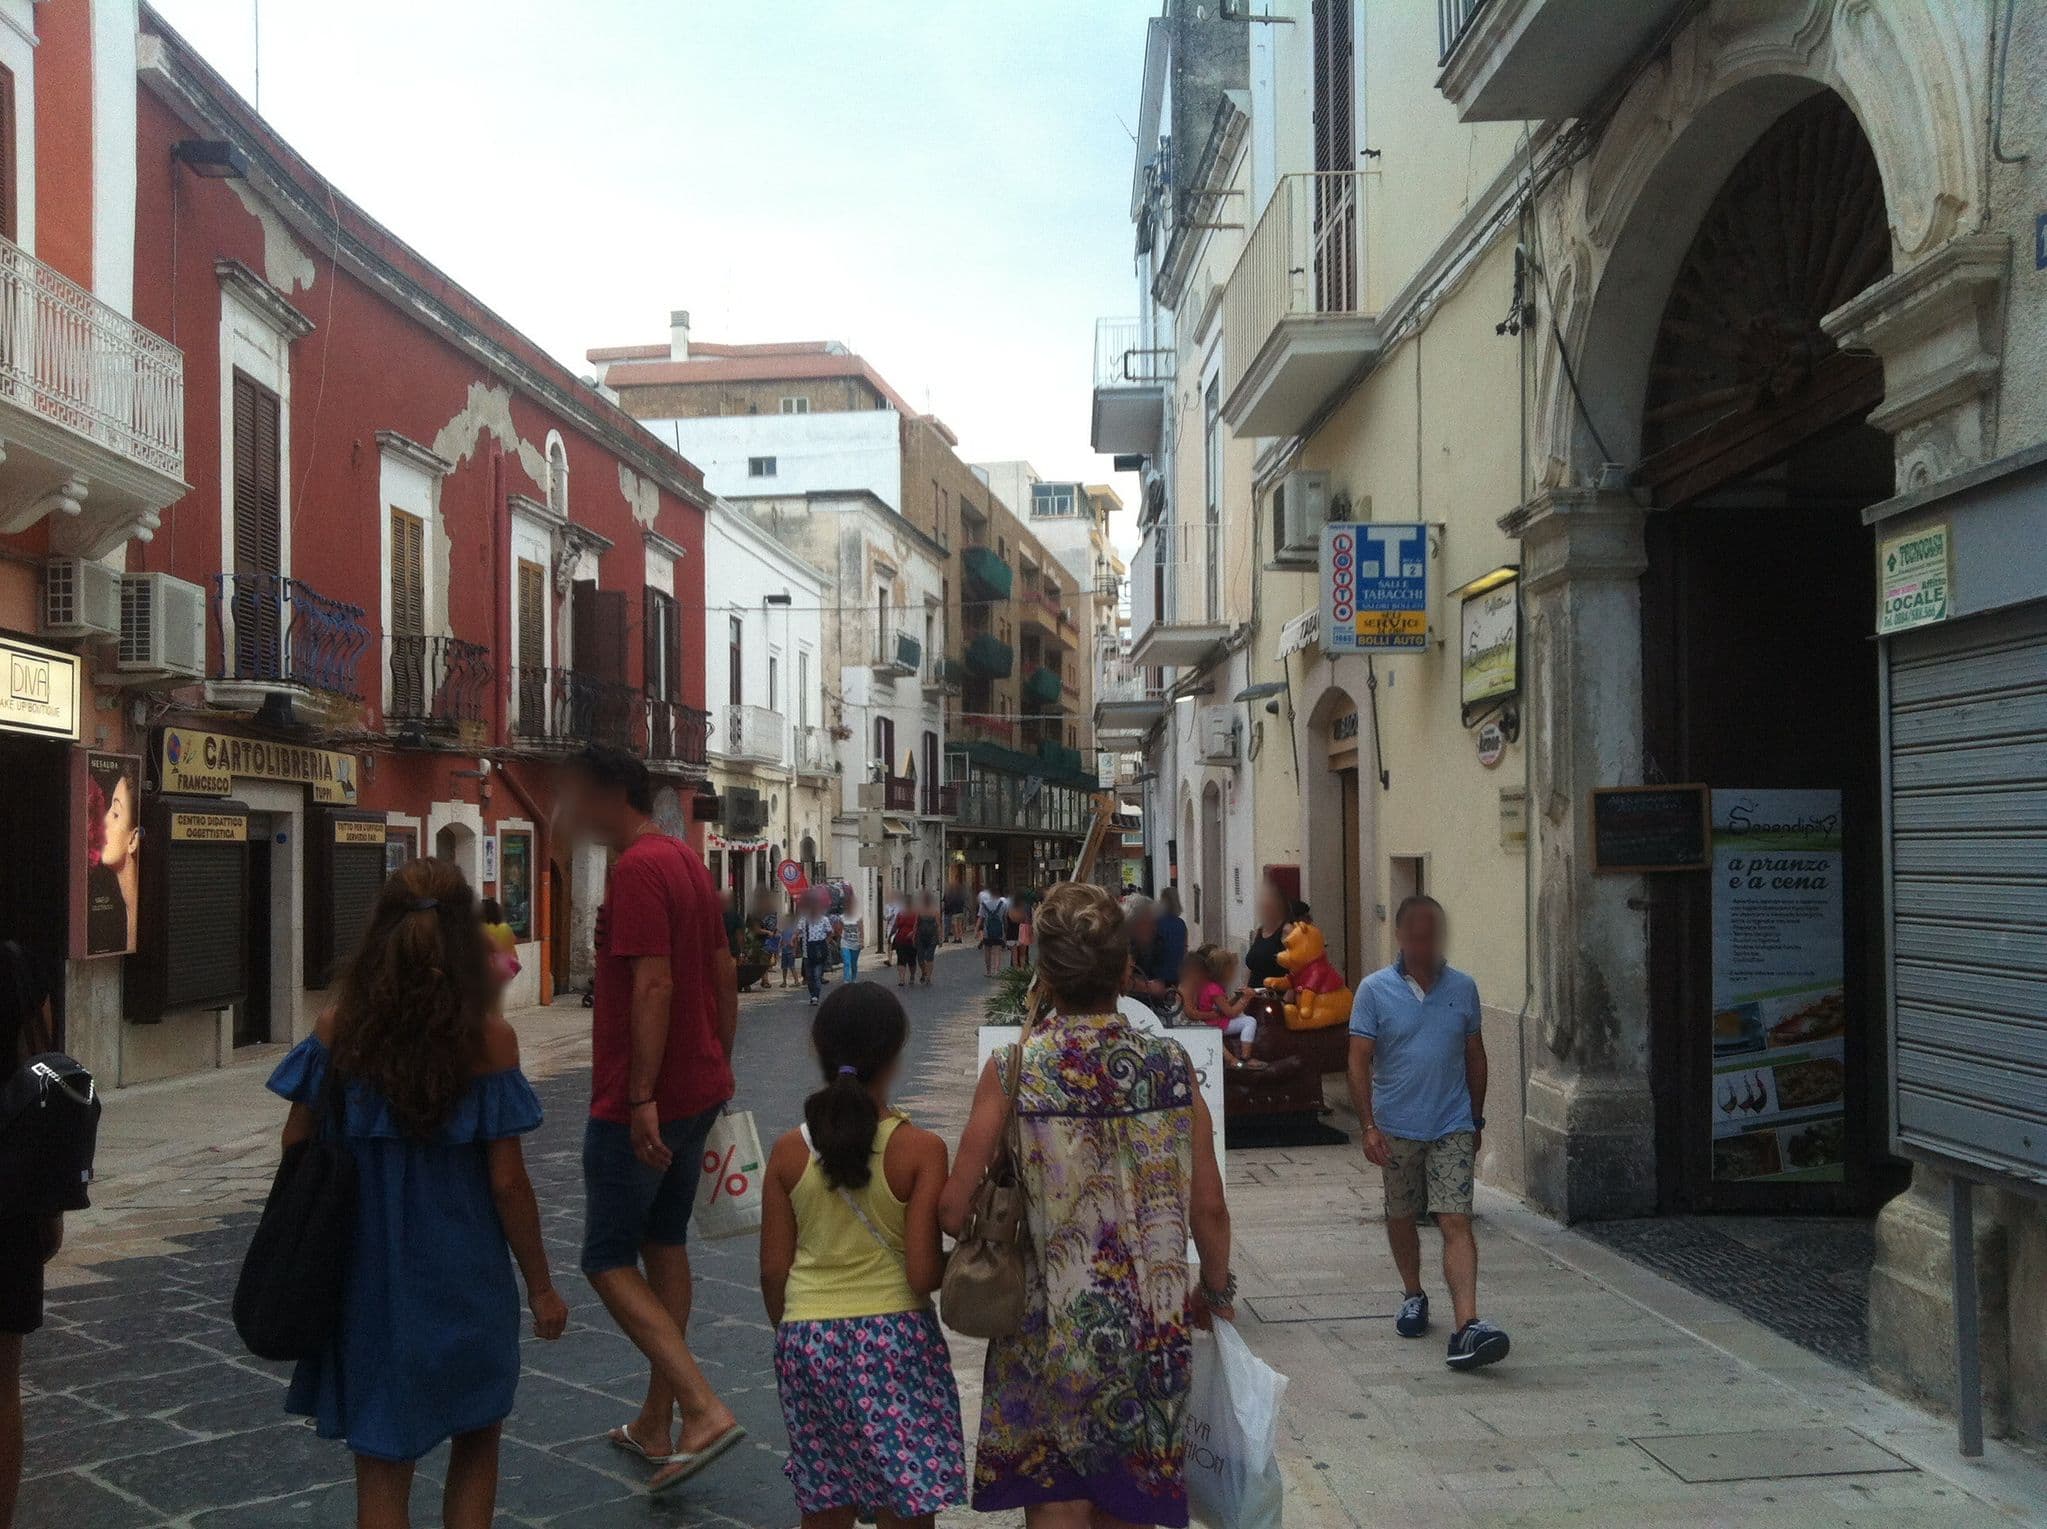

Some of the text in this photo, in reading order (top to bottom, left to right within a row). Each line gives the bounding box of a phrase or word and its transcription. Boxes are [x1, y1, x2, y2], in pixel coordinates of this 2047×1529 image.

[1363, 589, 1423, 600] TABACCHI
[1885, 586, 1944, 614] LOCALE
[1359, 636, 1424, 645] BOLLI AUTO
[14, 662, 46, 697] DIVA
[0, 698, 13, 711] AKE
[203, 736, 333, 780] CARTOLIBRERIA
[178, 774, 229, 792] FRANCESCO
[178, 815, 243, 827] CENTRO DIDATTICO
[186, 828, 235, 839] OGGETTISTICA
[1728, 859, 1831, 876] a pranzo
[1728, 877, 1829, 889] e a cena
[1184, 1440, 1224, 1473] HION
